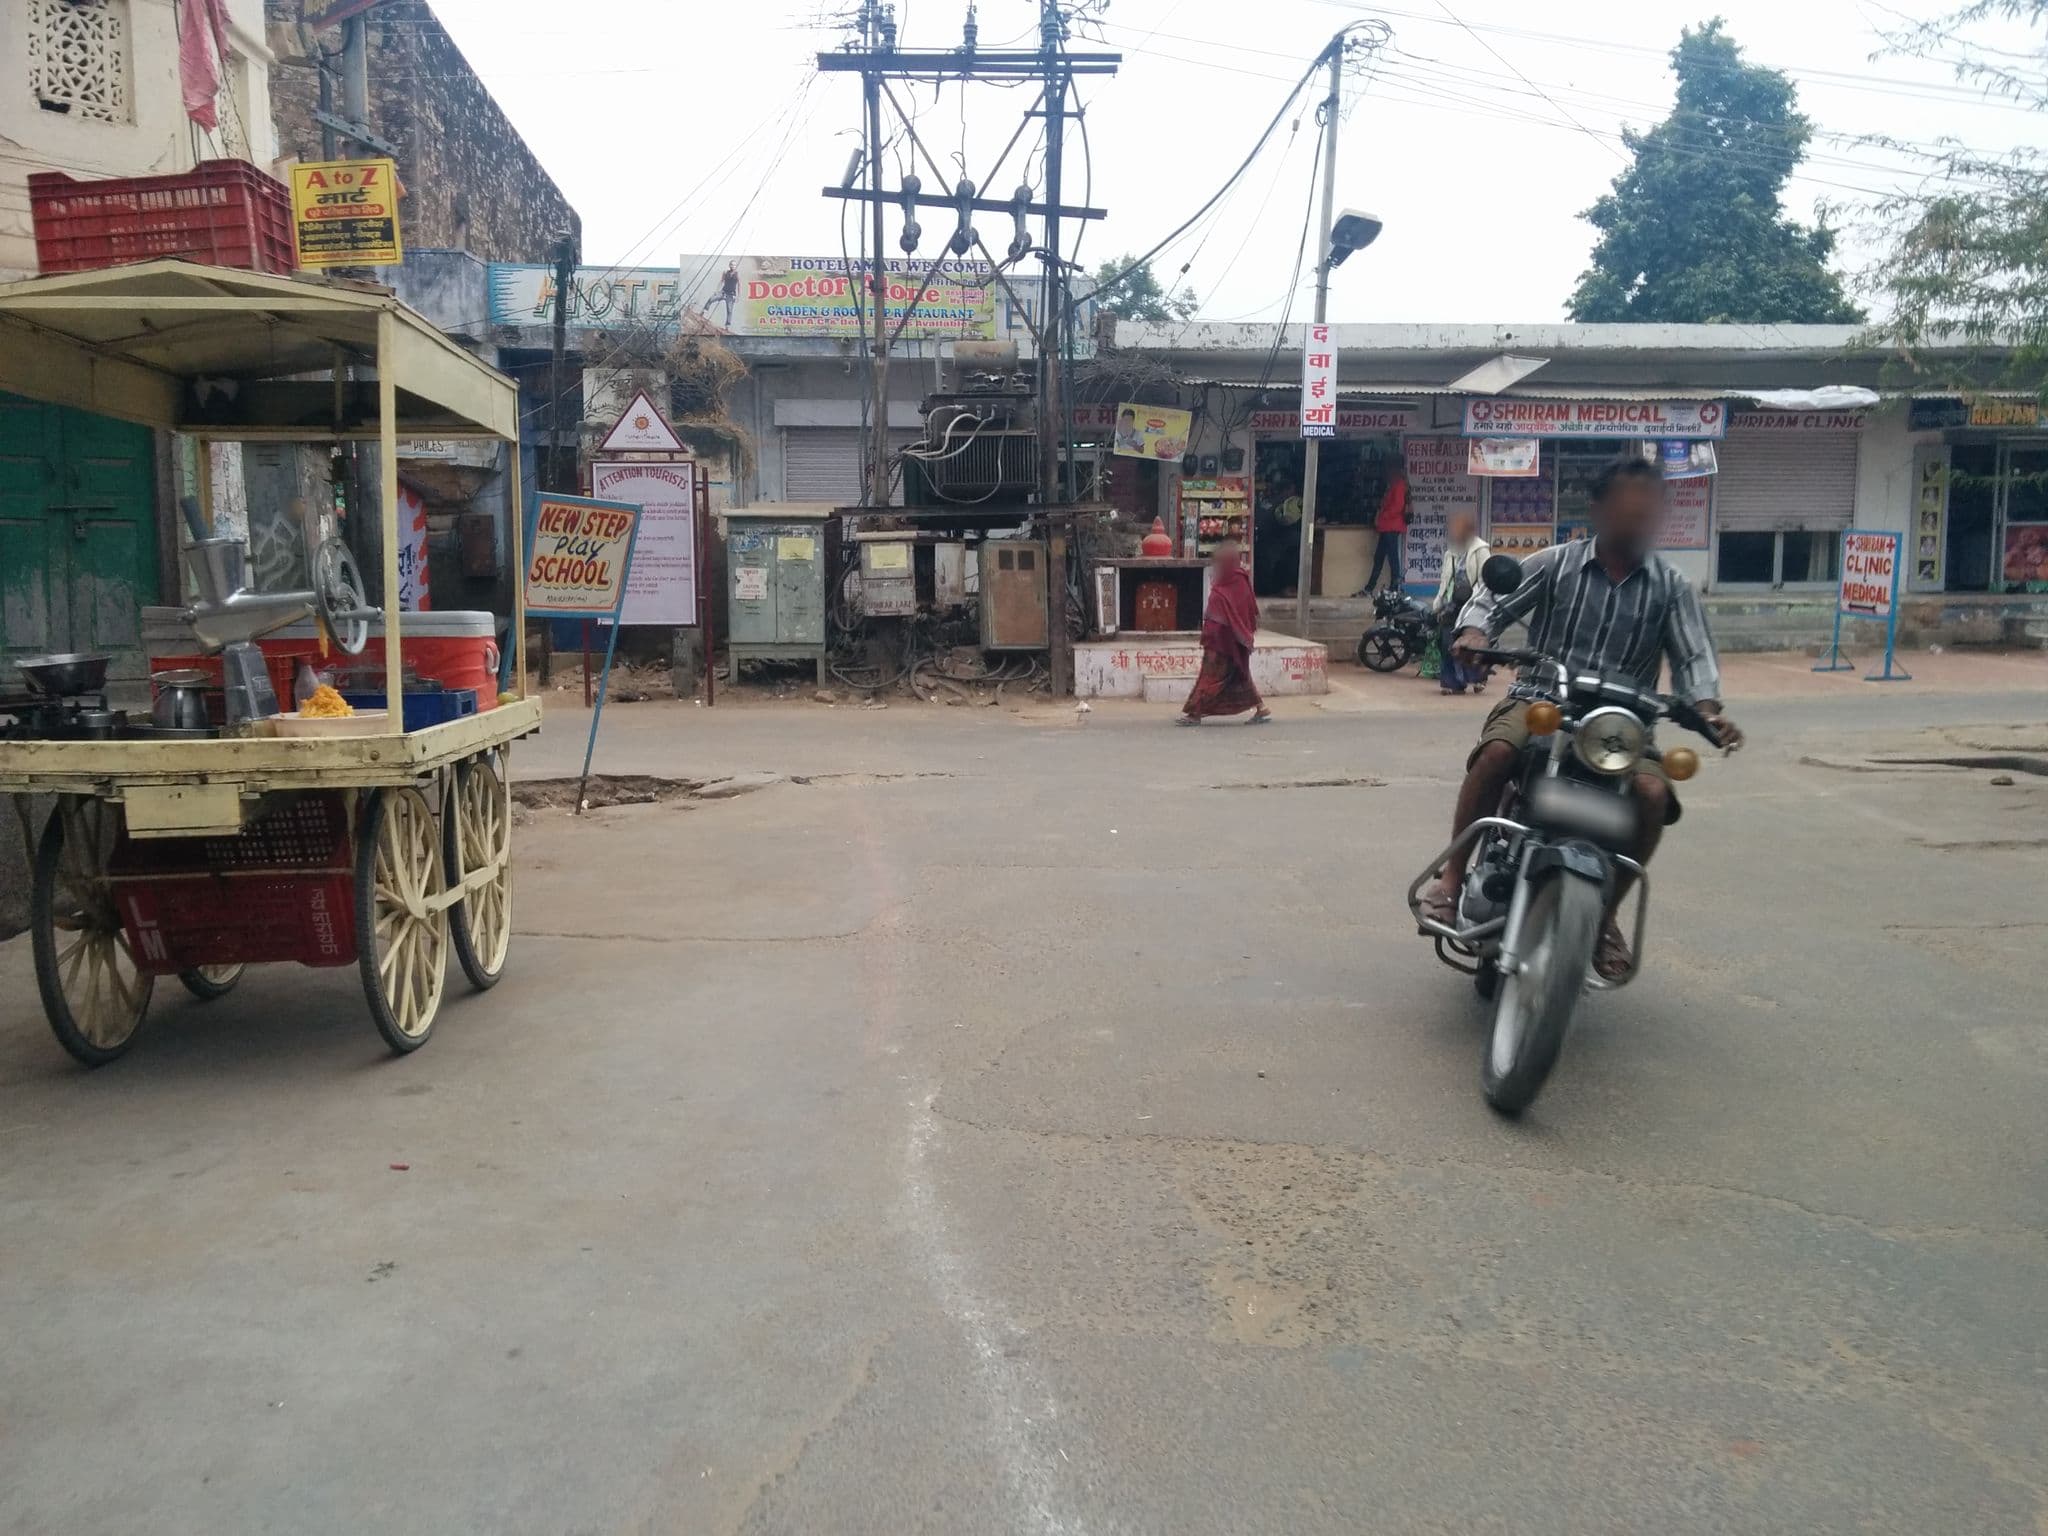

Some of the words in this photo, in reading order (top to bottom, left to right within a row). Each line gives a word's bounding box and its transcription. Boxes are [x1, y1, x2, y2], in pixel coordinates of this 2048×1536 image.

[306, 171, 328, 189] A
[333, 171, 354, 184] to
[360, 168, 379, 186] Z
[315, 187, 371, 204] मार्ट
[790, 259, 847, 270] HOTEL
[906, 261, 989, 272] WECOME
[748, 276, 849, 299] Doctor
[767, 305, 818, 316] GARDEN
[833, 306, 866, 317] ROO
[868, 308, 892, 319] TP
[1338, 414, 1408, 428] MEDICAL
[1493, 404, 1571, 420] SHRIRAM
[1577, 404, 1667, 422] MEDICAL
[1803, 415, 1865, 428] CLINIC
[1303, 427, 1335, 436] MEDICAL
[1409, 461, 1454, 475] MEDICAL
[598, 466, 643, 492] ATTENTION
[643, 466, 690, 491] TOURISTS
[539, 506, 581, 534] NEW
[582, 511, 628, 539] STEP
[530, 555, 609, 586] SCHOOL
[1846, 554, 1892, 576] CLINIC
[1842, 582, 1890, 605] MEDICAL
